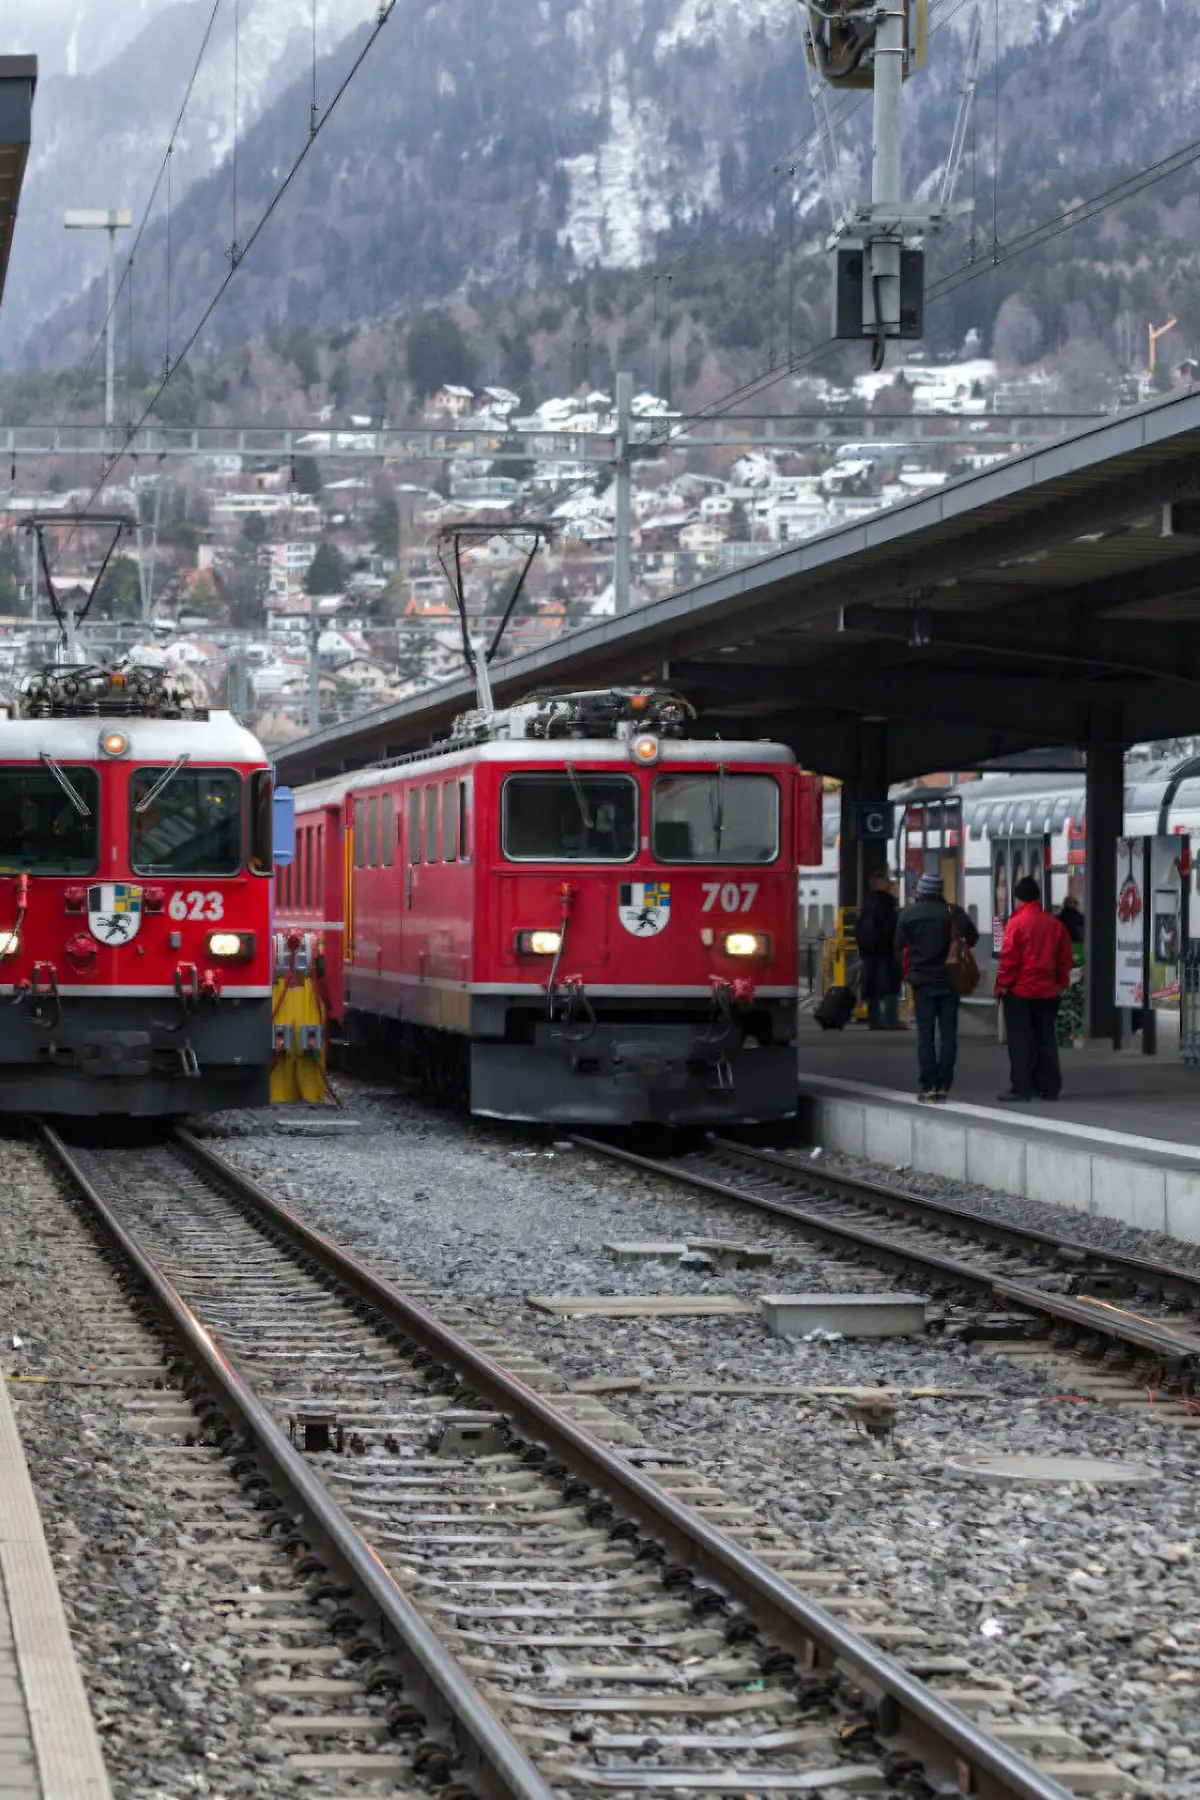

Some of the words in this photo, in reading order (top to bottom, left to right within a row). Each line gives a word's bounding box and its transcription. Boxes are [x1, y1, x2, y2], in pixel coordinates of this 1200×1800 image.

[866, 813, 884, 832] C
[168, 890, 224, 921] 623
[701, 883, 760, 913] 707
